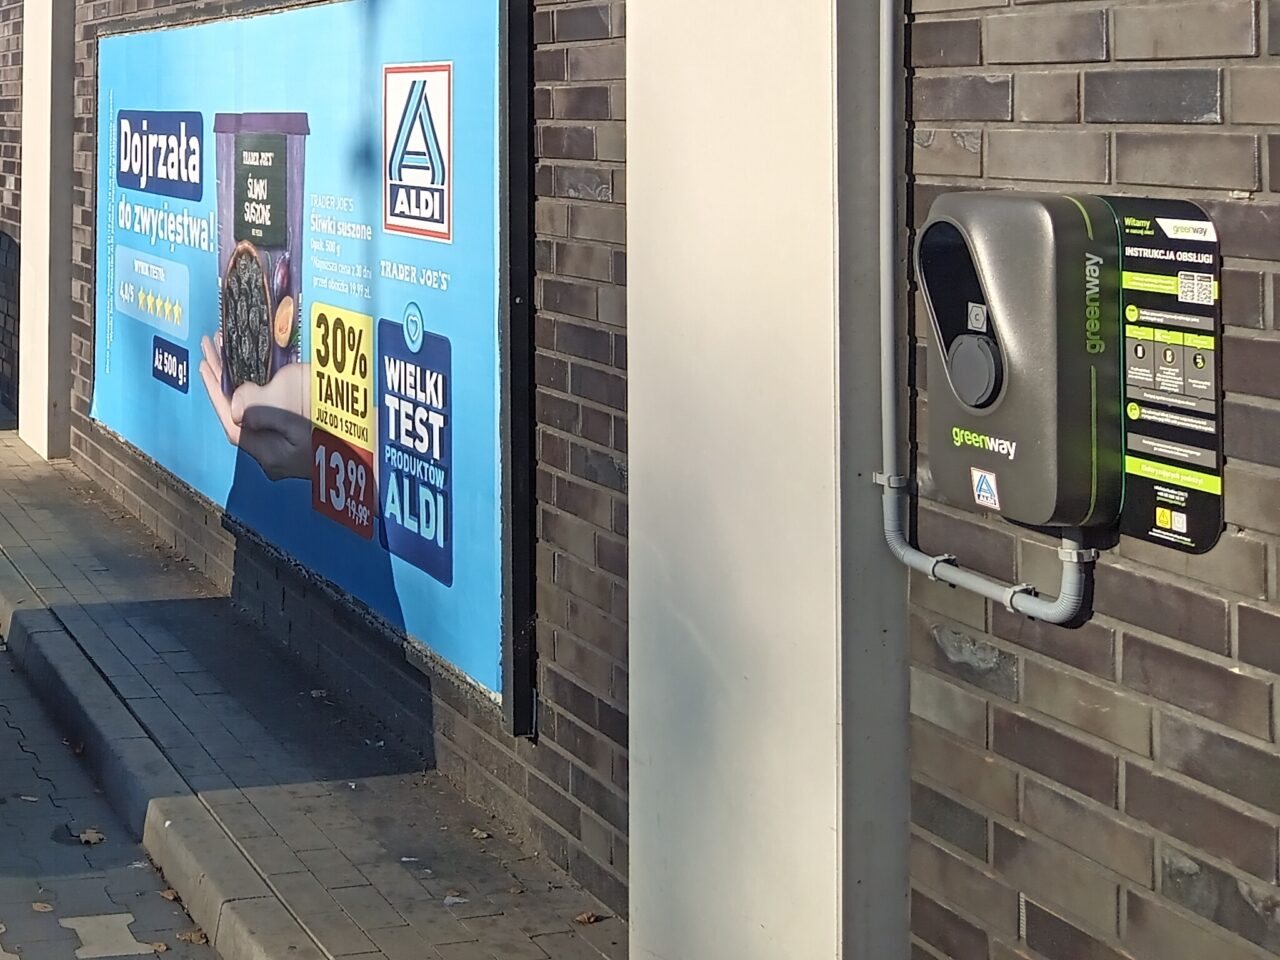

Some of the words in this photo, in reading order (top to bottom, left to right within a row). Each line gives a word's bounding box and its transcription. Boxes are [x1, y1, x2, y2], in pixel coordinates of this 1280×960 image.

[120, 119, 200, 189] Dojrzała
[247, 173, 268, 200] ŚLIWKI
[310, 193, 335, 211] TRADER
[394, 188, 440, 219] ALDI
[119, 193, 132, 231] do
[133, 201, 214, 252] zwycięstwa!
[244, 202, 271, 226] SUSZONE
[311, 208, 337, 236] Śliwki
[337, 221, 372, 241] suszone
[1124, 217, 1151, 229] Witamy
[1172, 225, 1207, 237] greenway
[380, 260, 417, 283] TRADER
[1125, 246, 1175, 261] INSTRUKCJA
[1176, 251, 1213, 265] OBSŁUGI
[1086, 252, 1105, 354] greenway
[153, 347, 163, 371] Aż
[163, 352, 176, 378] 500
[315, 313, 368, 380] 30%
[316, 371, 368, 419] TANIEJ
[384, 355, 444, 410] WIELKI
[316, 405, 329, 426] JUŻ
[328, 414, 339, 430] OD
[340, 417, 344, 432] 1
[344, 422, 369, 443] SZTUKI
[384, 394, 445, 461] TEST
[952, 426, 1017, 460] greenway
[384, 444, 446, 489] PRODUKTÓW
[384, 471, 445, 549] ALDI
